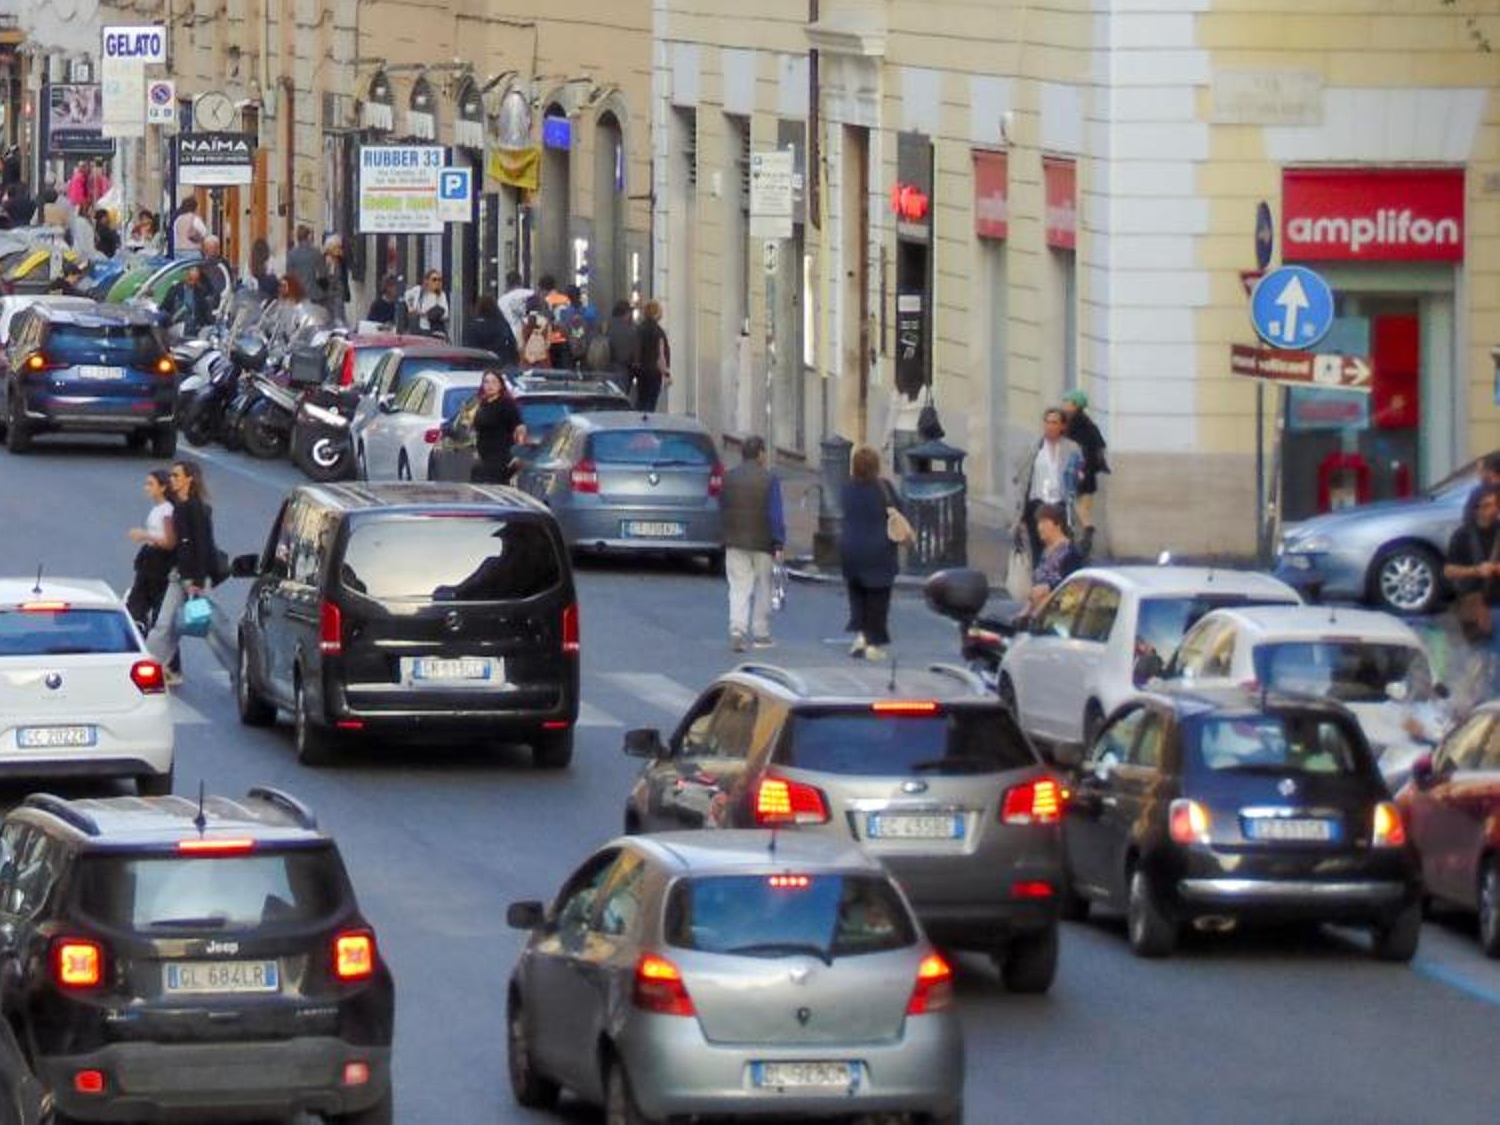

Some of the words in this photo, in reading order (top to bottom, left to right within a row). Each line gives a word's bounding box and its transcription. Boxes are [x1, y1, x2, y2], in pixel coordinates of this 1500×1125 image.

[106, 34, 161, 57] GELATO
[181, 136, 248, 151] NAÏMA
[363, 149, 419, 167] RUBBER
[423, 149, 440, 167] 33
[445, 174, 462, 197] P
[1286, 208, 1459, 252] amplifon
[205, 940, 239, 956] Jeep
